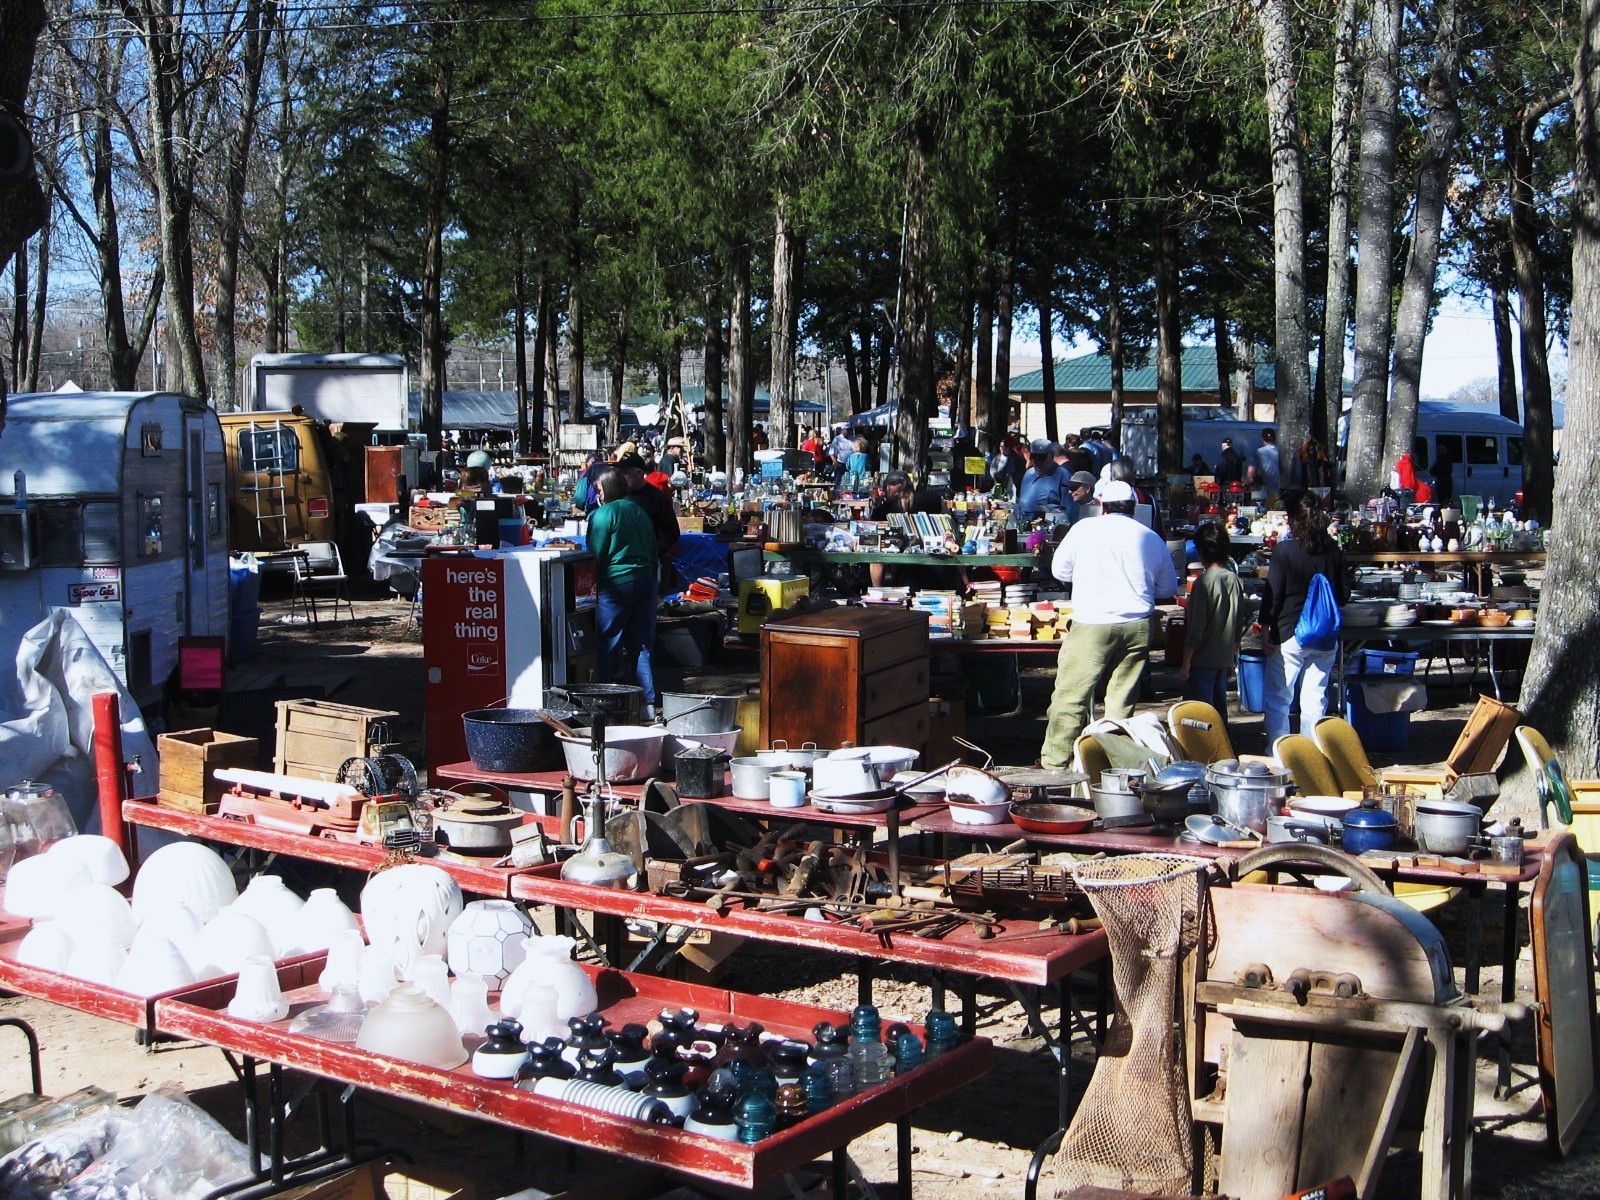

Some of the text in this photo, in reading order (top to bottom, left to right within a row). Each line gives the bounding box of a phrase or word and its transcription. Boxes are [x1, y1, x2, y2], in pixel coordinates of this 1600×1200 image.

[446, 567, 497, 583] here's
[468, 586, 497, 602] the
[465, 603, 498, 619] real
[454, 622, 498, 641] thing
[471, 653, 492, 664] Coke
